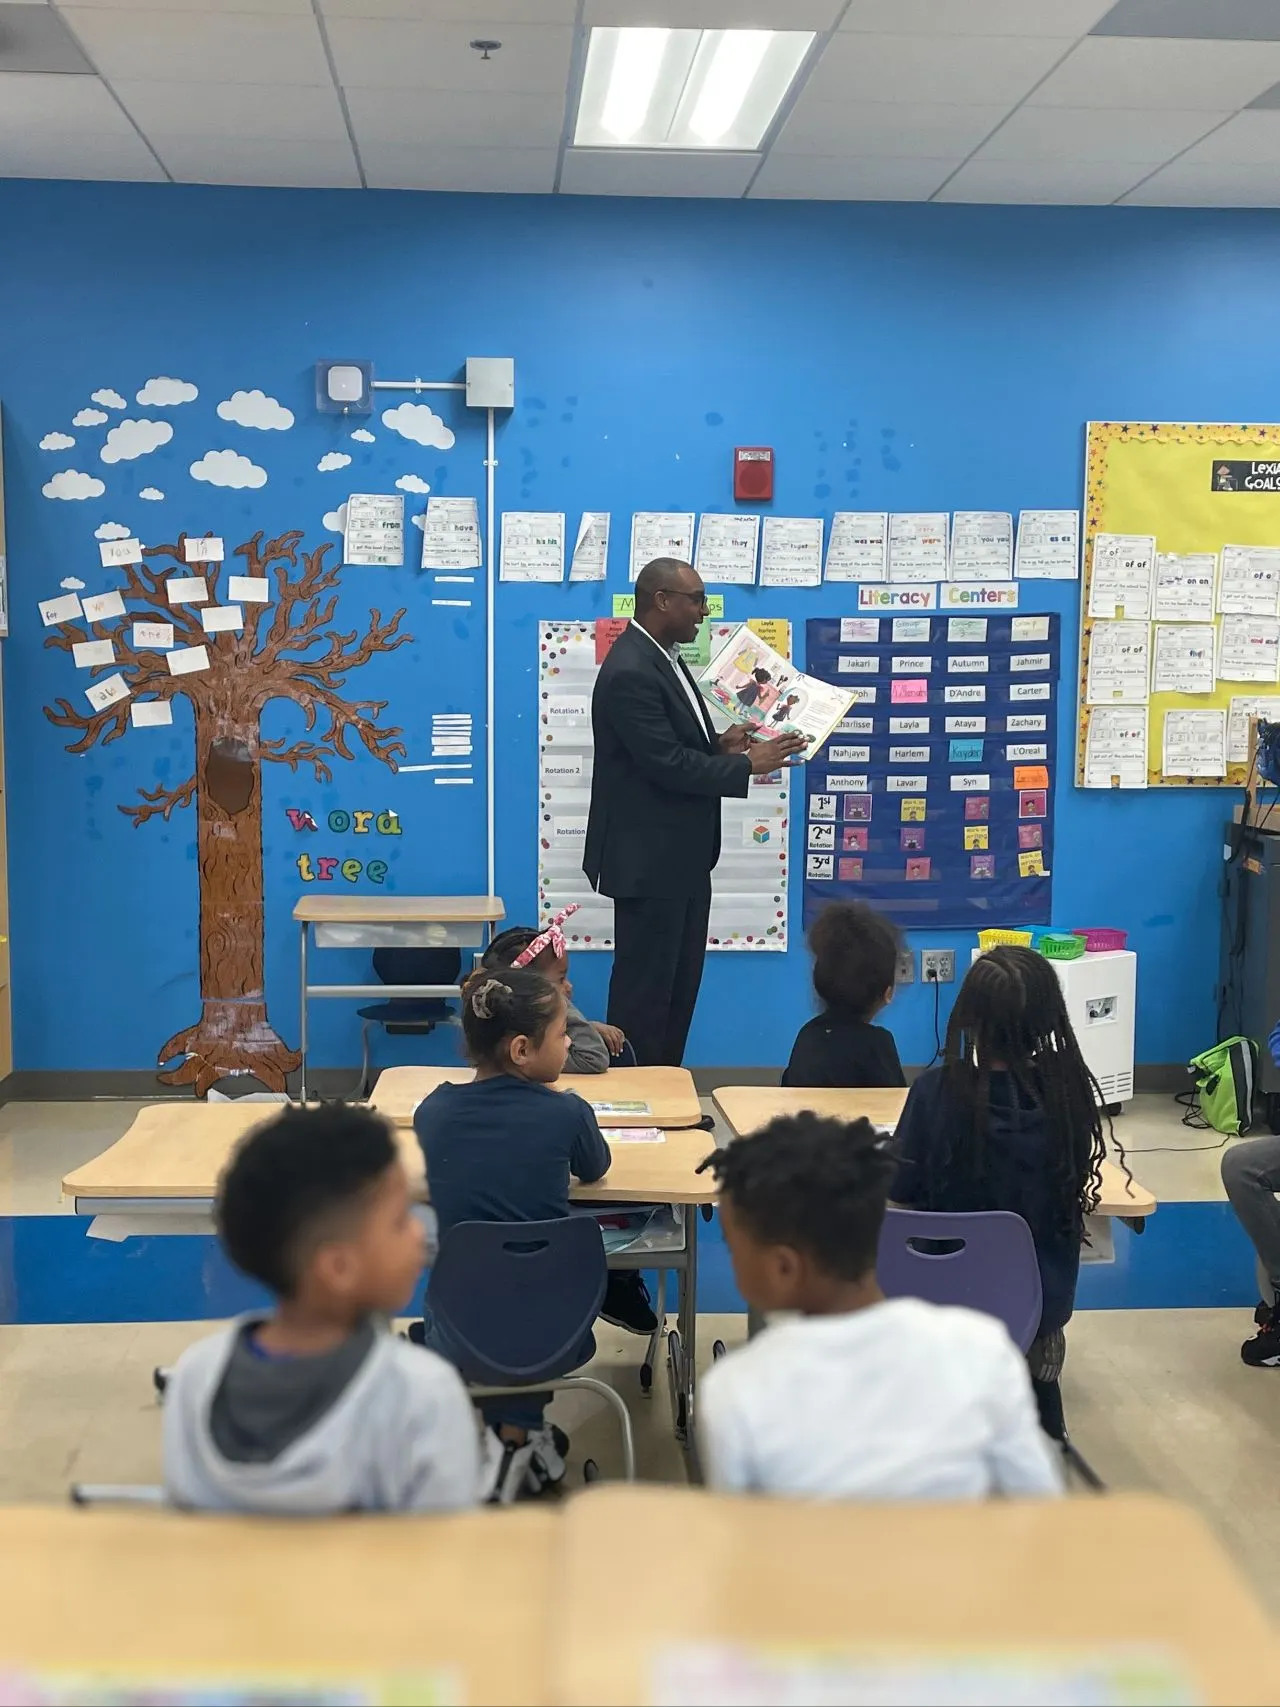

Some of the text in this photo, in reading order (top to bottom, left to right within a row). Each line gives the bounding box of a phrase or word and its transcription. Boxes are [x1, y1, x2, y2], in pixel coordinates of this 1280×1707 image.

[1125, 560, 1147, 568] of of
[1254, 571, 1264, 579] of
[1187, 577, 1209, 585] on on
[860, 588, 931, 607] Literacy
[948, 587, 1016, 603] Centers
[1121, 646, 1144, 654] of of
[847, 659, 871, 668] Jakari
[899, 660, 924, 668] Prince
[951, 659, 985, 668] Autumn
[1016, 657, 1043, 667] Jahmir
[949, 688, 981, 698] D'Andre
[1017, 686, 1043, 696] Carter
[550, 707, 586, 715] Rotation 1
[899, 720, 920, 730] Layla
[954, 719, 977, 729] Ataya
[1010, 718, 1041, 728] Zachary
[833, 749, 865, 759] Nahjaye
[895, 749, 924, 758] Harlem
[1013, 746, 1040, 755] L'Oreal
[545, 767, 580, 775] Rotation 2
[830, 778, 864, 788] Anthony
[896, 779, 917, 787] Lavar
[963, 777, 977, 787] Syn
[817, 796, 831, 810] 1st
[556, 828, 586, 836] Rotation
[812, 825, 832, 840] 2nd
[296, 852, 389, 884] tree
[812, 856, 830, 870] 3rd
[808, 871, 832, 879] Rotation
